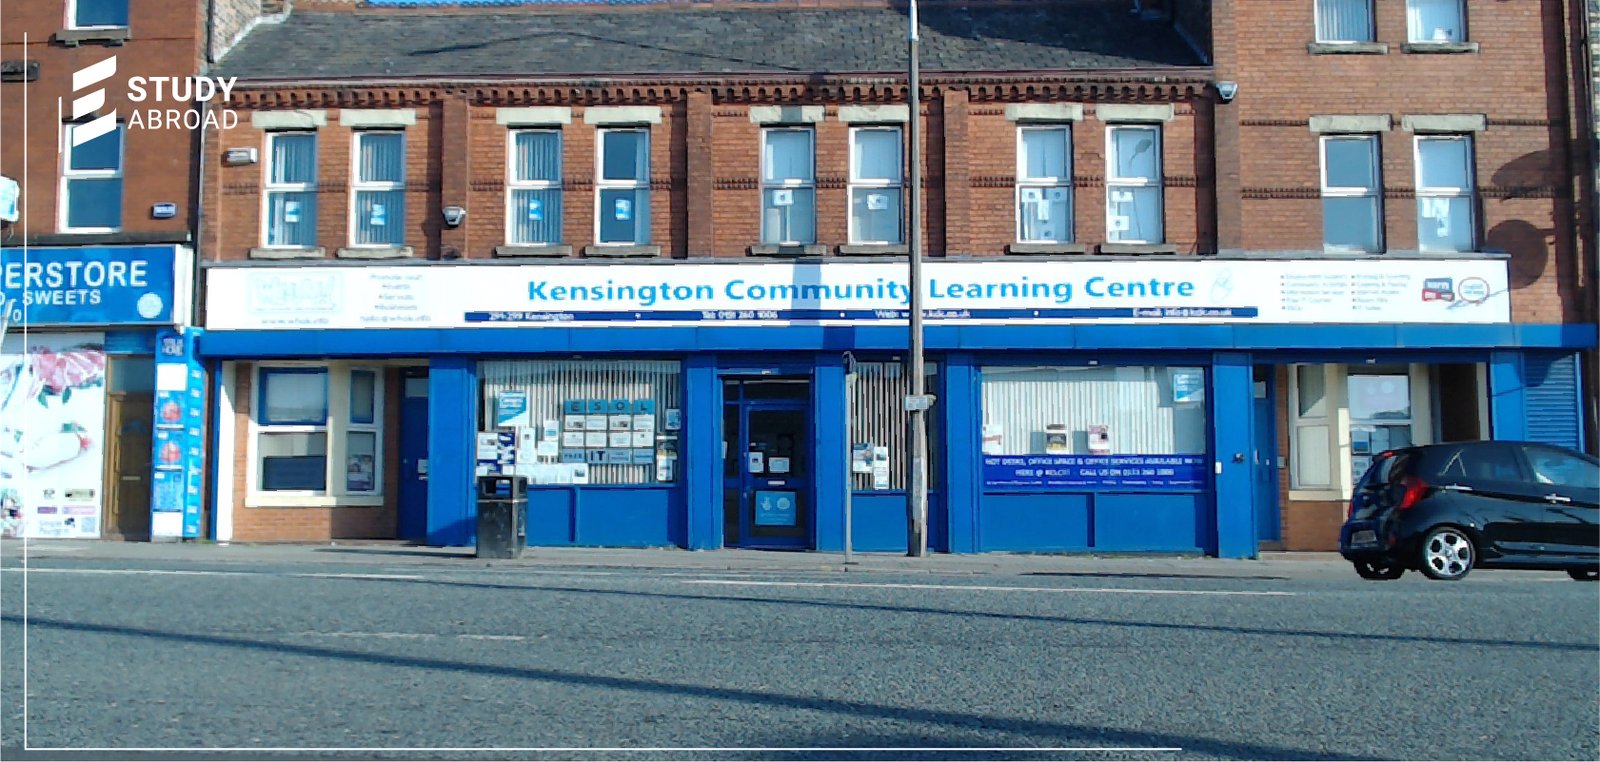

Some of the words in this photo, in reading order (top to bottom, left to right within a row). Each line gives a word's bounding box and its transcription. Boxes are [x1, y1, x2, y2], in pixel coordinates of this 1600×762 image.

[0, 261, 148, 289] ERSTORE
[22, 289, 102, 306] SWEETS
[527, 279, 714, 306] Kensington
[725, 279, 911, 304] Community
[929, 276, 1073, 303] Learning
[1084, 275, 1195, 298] Centre
[525, 311, 575, 322] Kensington
[590, 450, 606, 461] IT
